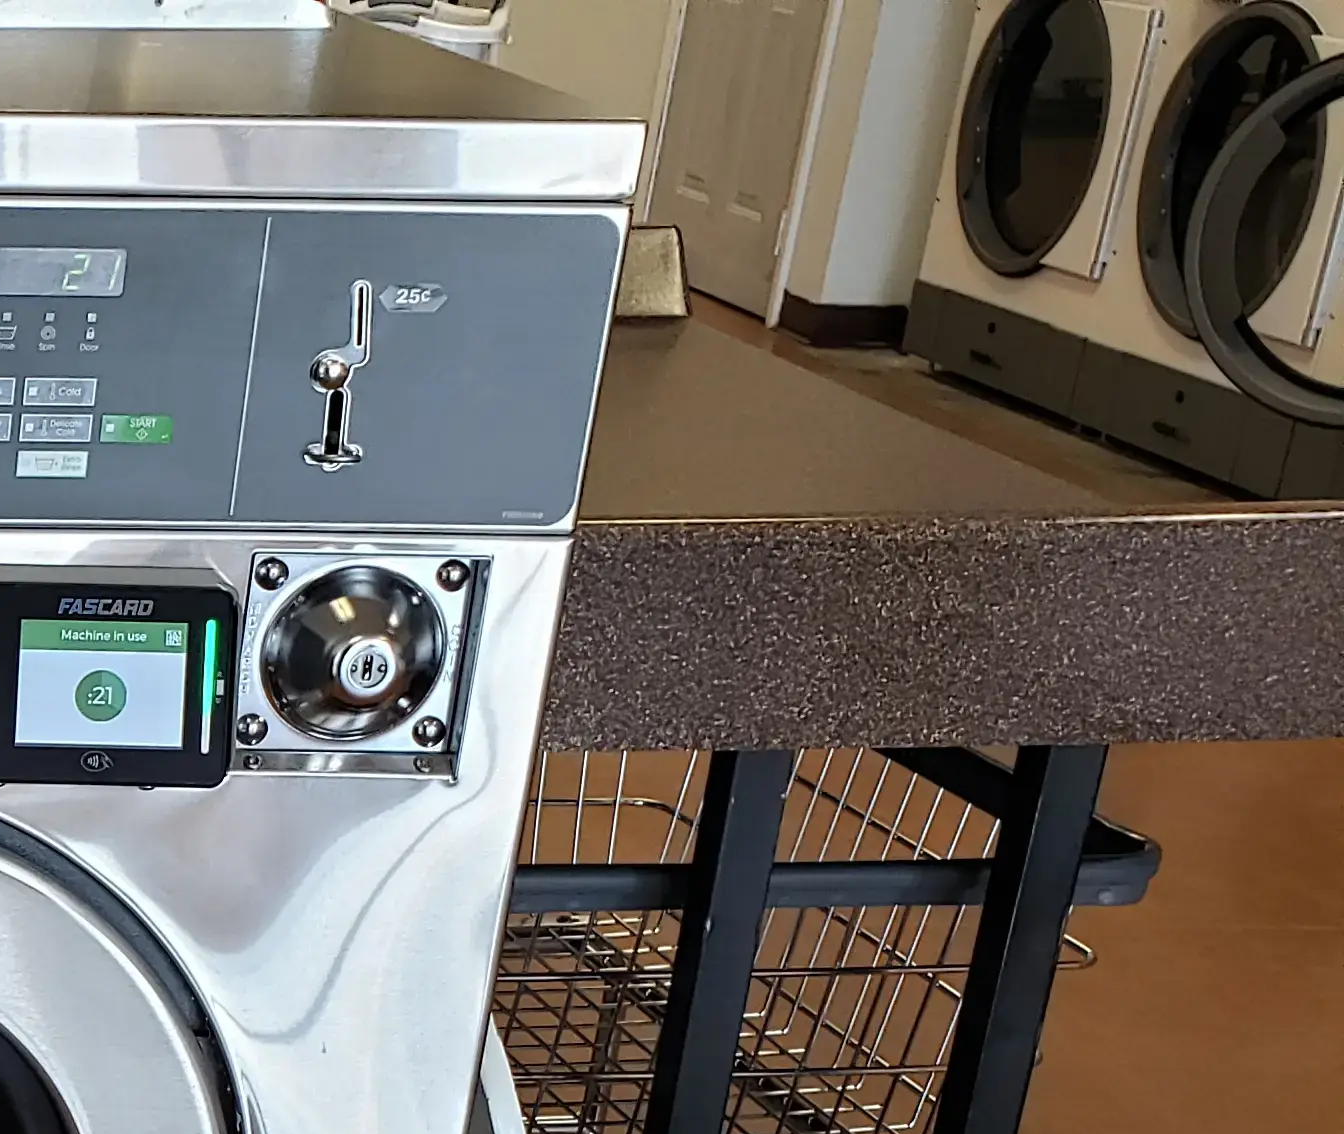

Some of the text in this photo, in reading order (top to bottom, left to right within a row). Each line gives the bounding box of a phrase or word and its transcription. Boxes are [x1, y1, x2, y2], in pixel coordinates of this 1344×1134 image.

[39, 343, 55, 351] Spin
[80, 343, 99, 351] Door
[58, 388, 81, 396] Cold
[129, 417, 157, 428] START
[58, 597, 154, 616] FASCARD
[61, 629, 147, 642] Machine in use
[87, 686, 113, 705] :21
